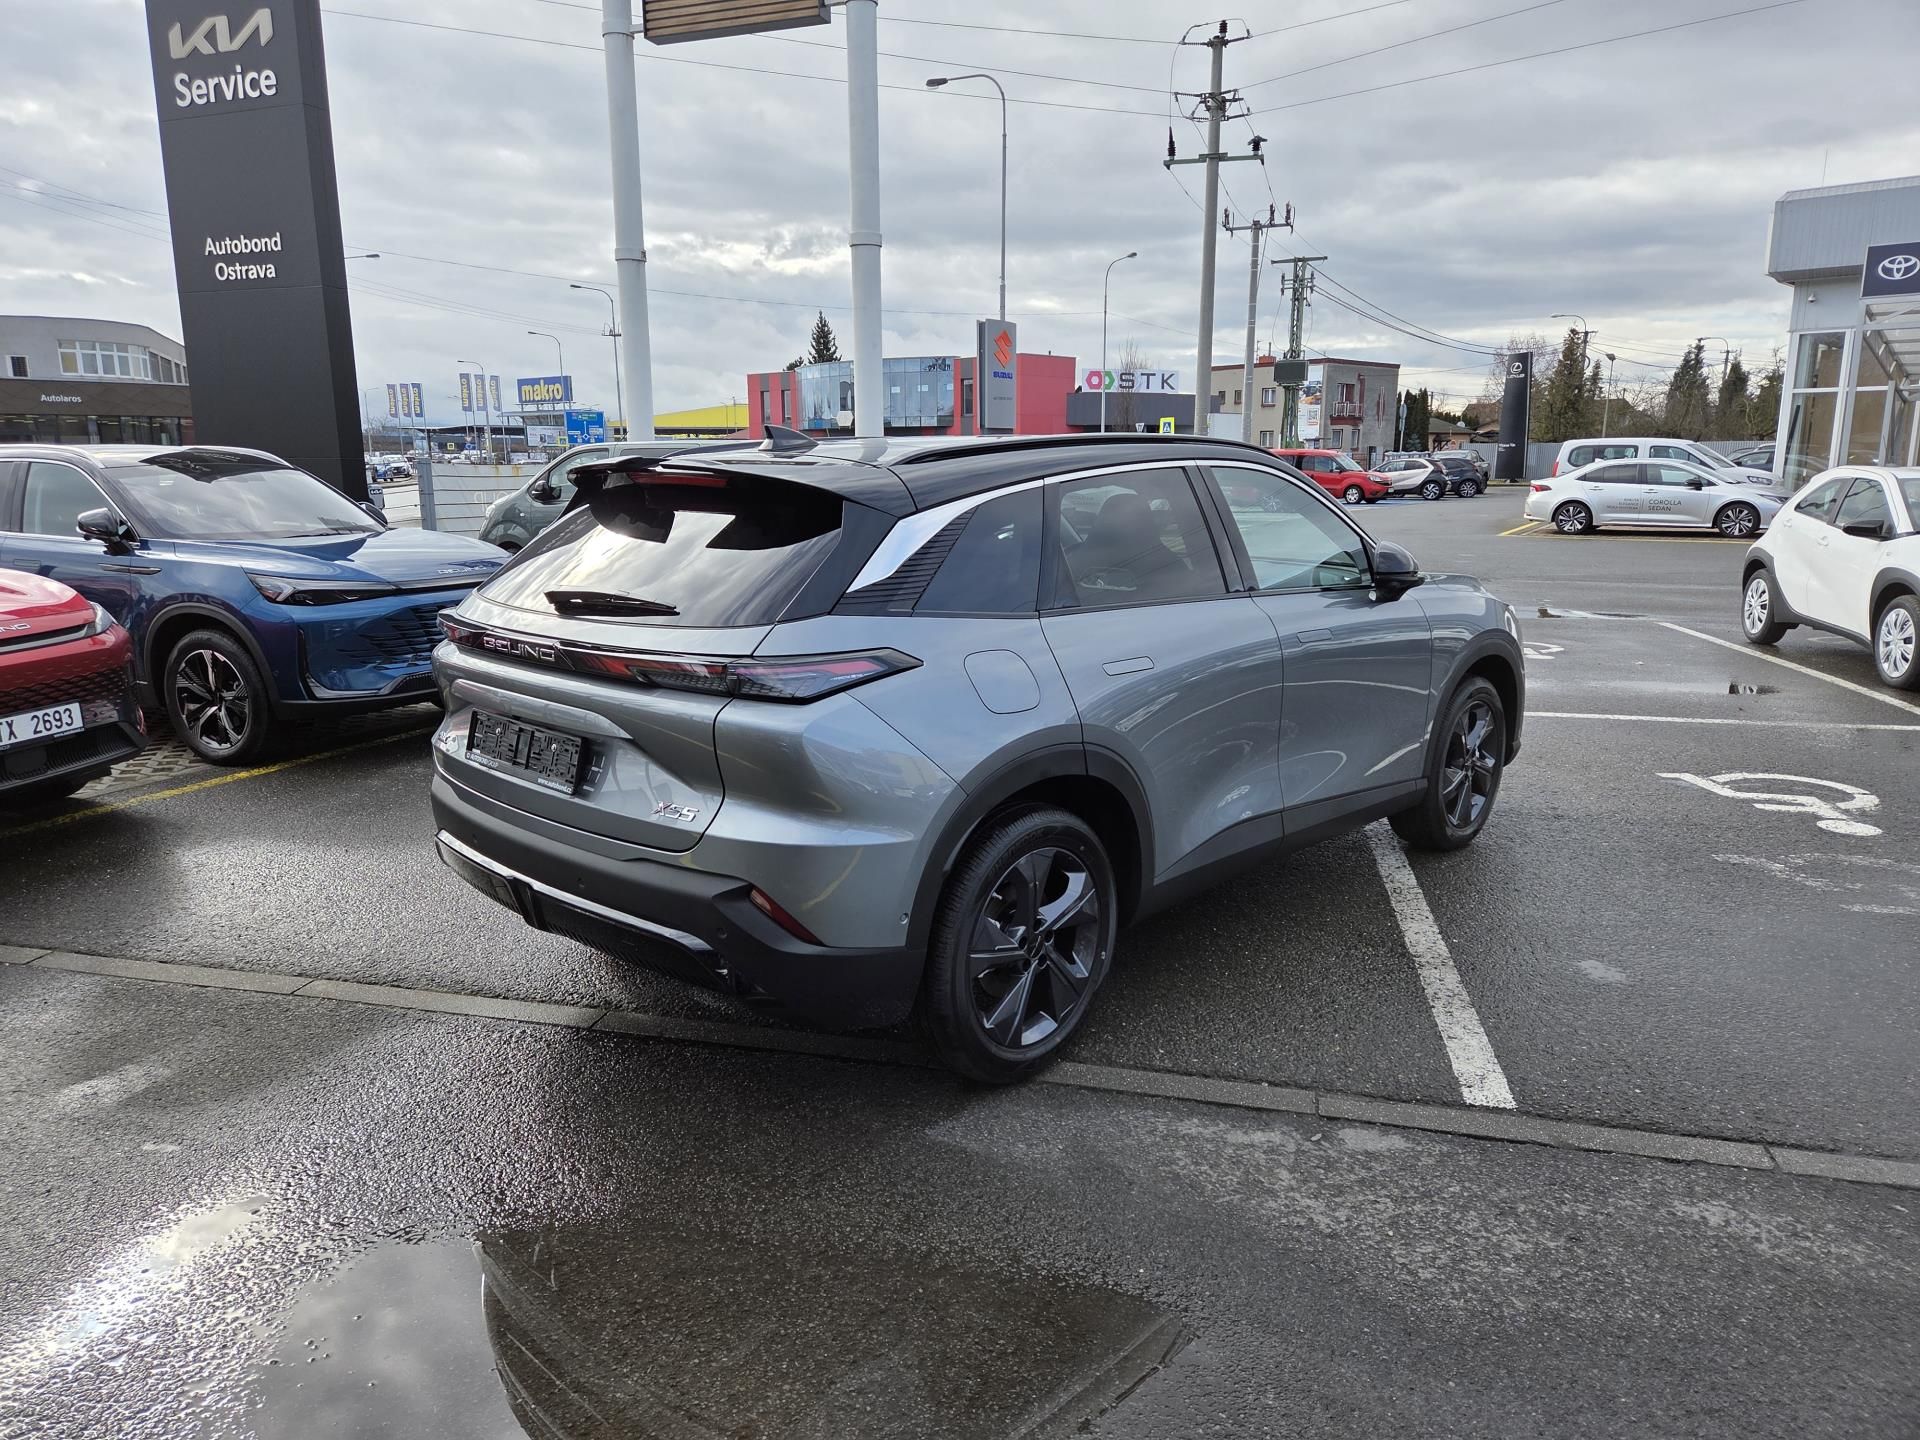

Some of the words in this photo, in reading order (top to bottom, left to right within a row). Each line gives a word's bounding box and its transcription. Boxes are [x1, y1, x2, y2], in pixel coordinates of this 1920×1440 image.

[174, 64, 277, 107] Service
[205, 232, 282, 256] Autobond
[215, 262, 276, 280] Ostrava
[521, 379, 563, 401] makro
[1119, 372, 1175, 390] STK
[40, 394, 82, 403] Autolaros
[483, 637, 555, 661] BEIJING
[30, 708, 74, 735] 2693
[650, 800, 700, 822] X55
